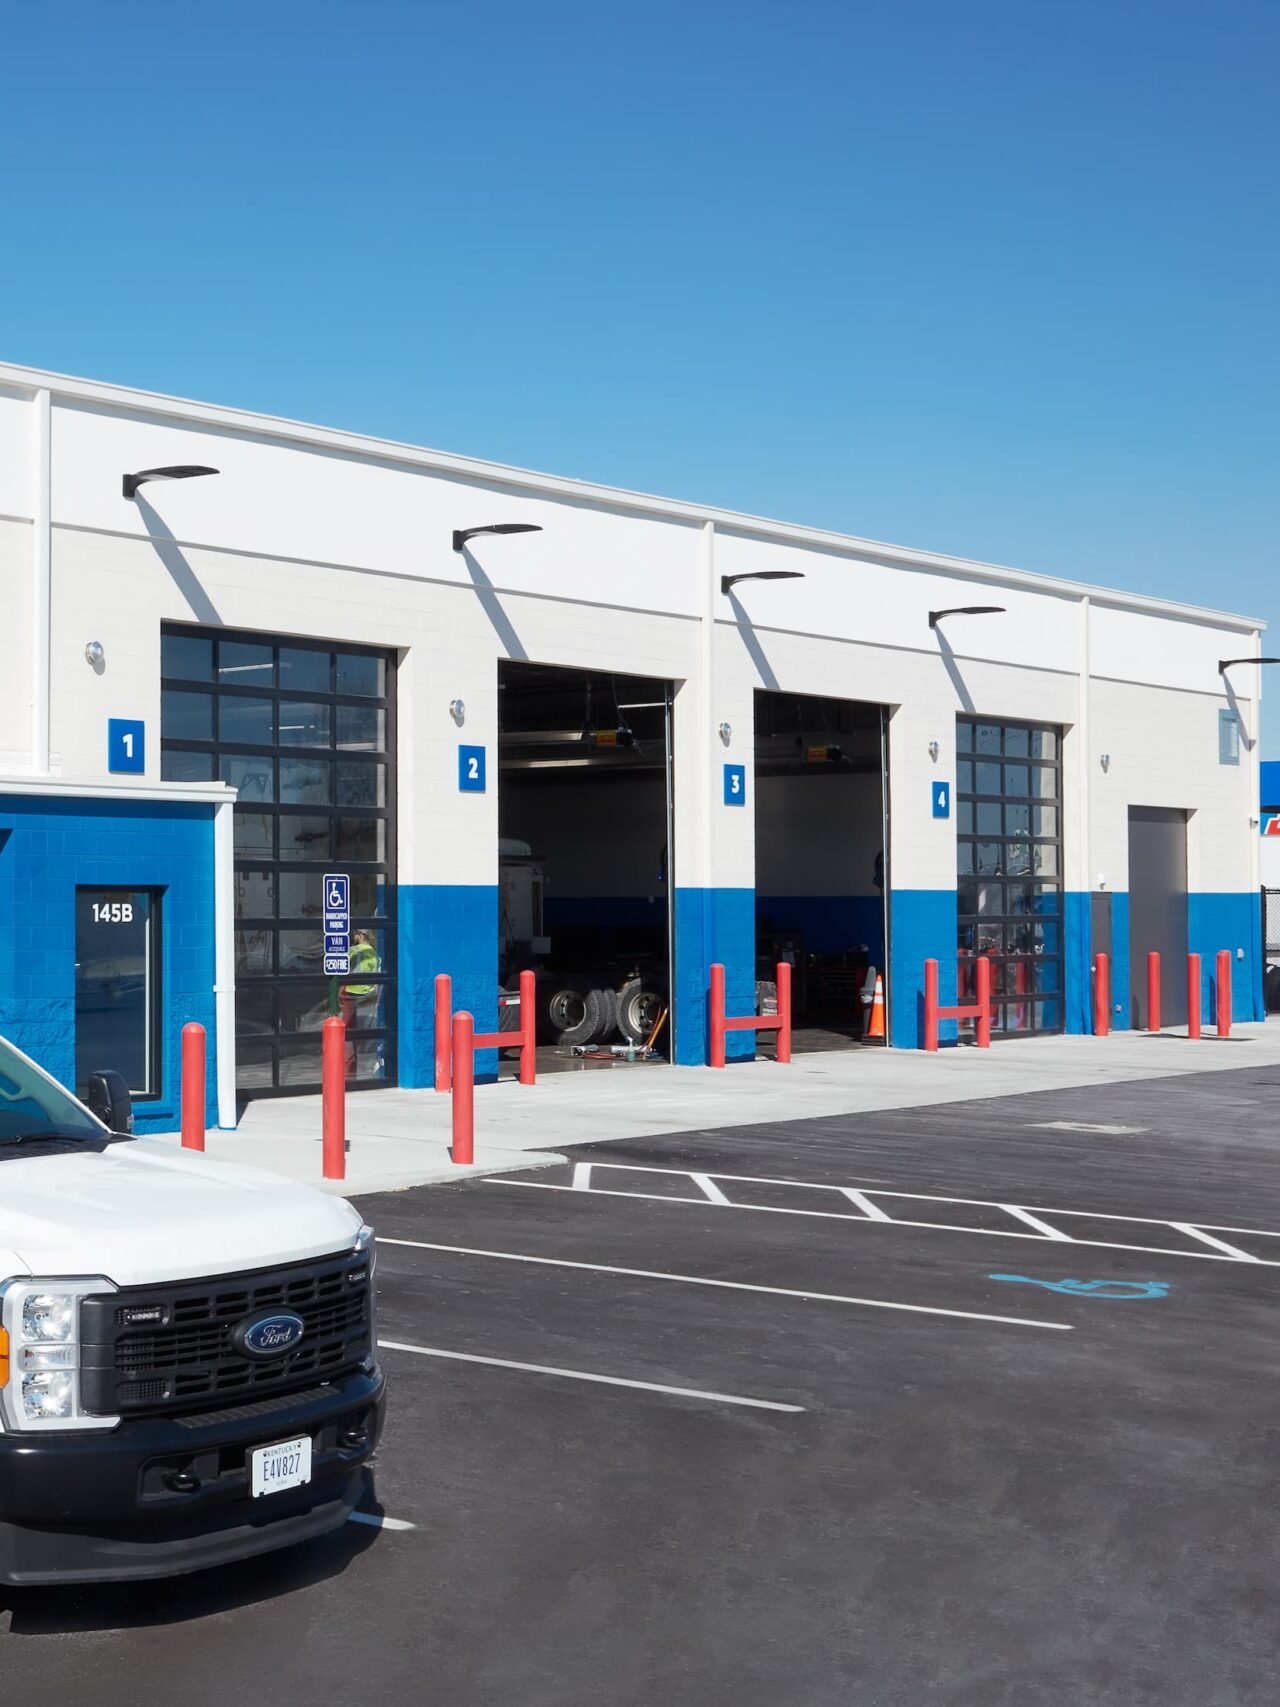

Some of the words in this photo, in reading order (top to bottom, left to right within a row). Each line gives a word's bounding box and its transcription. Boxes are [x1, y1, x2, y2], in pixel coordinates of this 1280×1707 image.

[122, 733, 133, 758] 1
[468, 757, 479, 779] 2
[731, 774, 740, 794] 3
[938, 791, 946, 808] 4
[92, 903, 133, 923] 145B
[331, 936, 344, 946] VAN
[260, 1324, 293, 1347] Ford
[263, 1452, 301, 1482] E4V827
